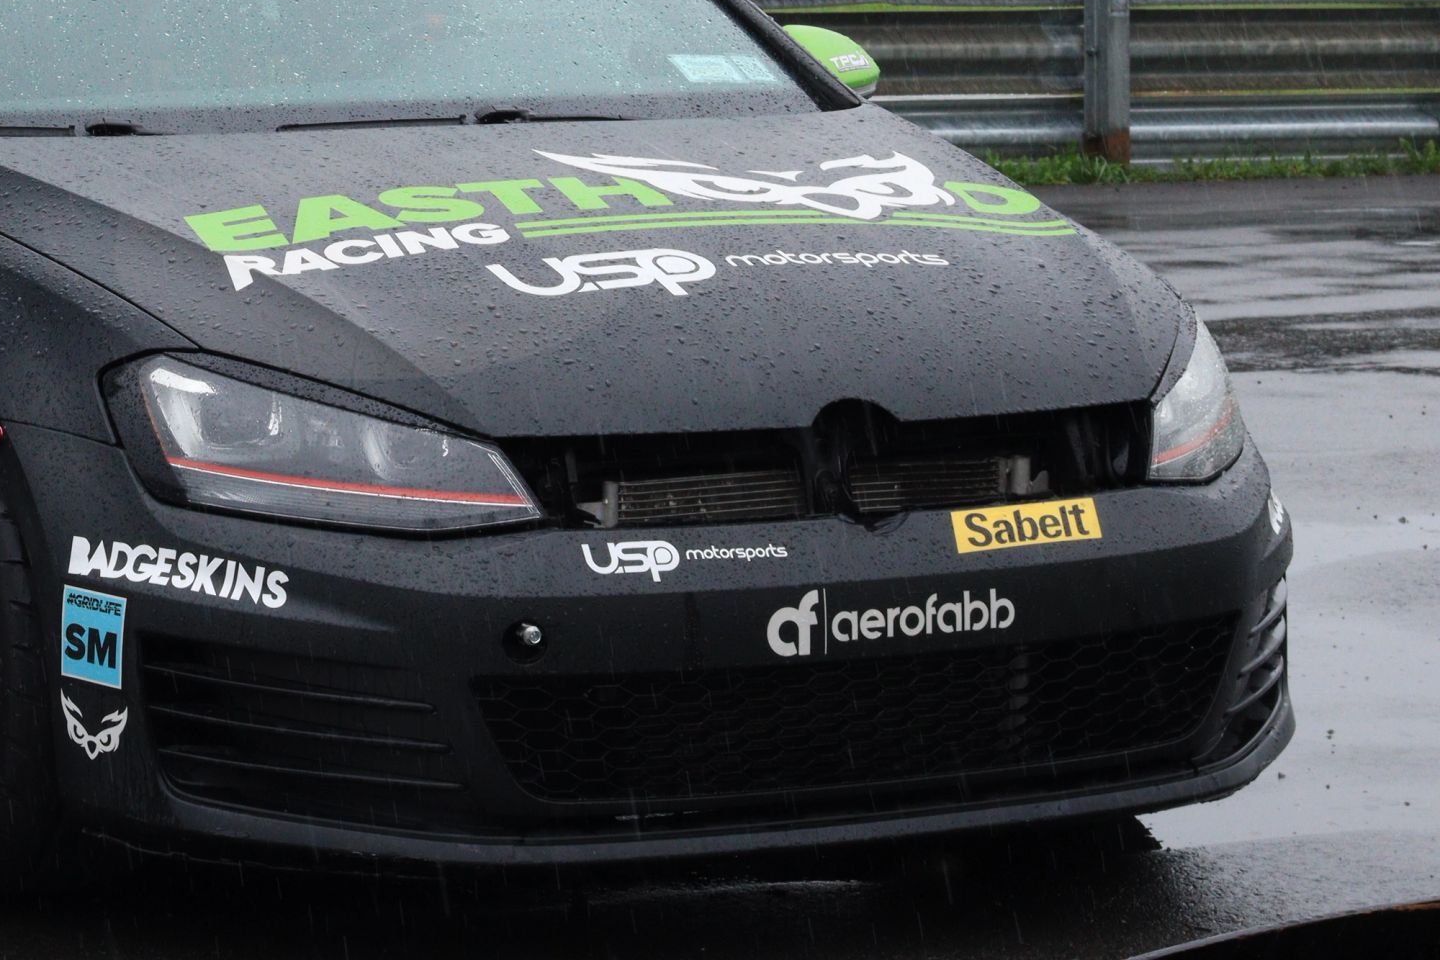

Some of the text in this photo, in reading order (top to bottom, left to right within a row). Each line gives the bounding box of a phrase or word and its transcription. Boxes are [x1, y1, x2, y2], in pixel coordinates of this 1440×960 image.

[222, 223, 511, 291] RACING
[724, 249, 950, 269] motorsports
[964, 503, 1091, 547] Sabelt
[67, 535, 290, 609] BADGESKINS
[685, 543, 789, 562] motorsports
[66, 592, 123, 617] #GRIDLIFE
[831, 588, 1016, 642] aerofabb
[64, 622, 118, 670] SM
